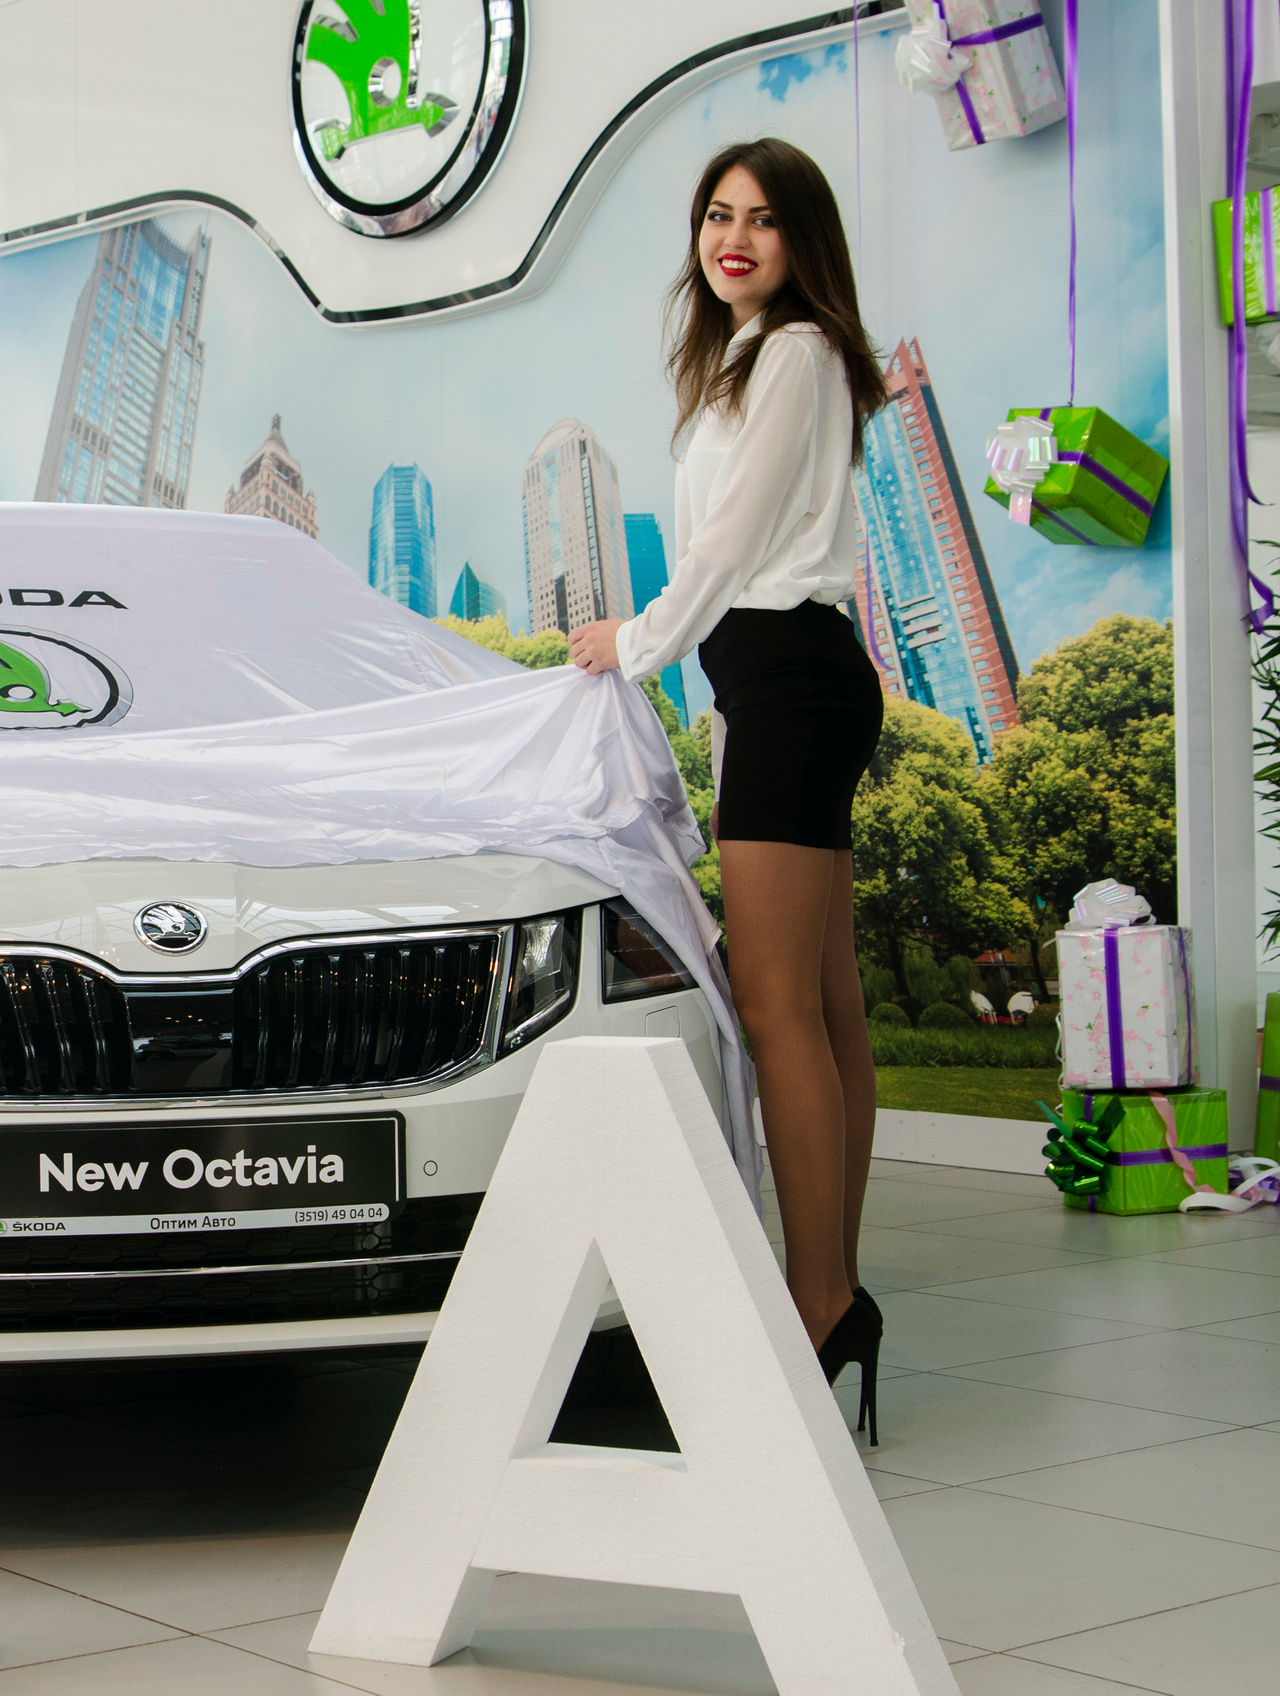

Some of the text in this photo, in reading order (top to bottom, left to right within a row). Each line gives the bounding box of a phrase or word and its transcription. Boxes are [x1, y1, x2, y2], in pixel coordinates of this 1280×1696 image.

[38, 1144, 345, 1193] New Octavia
[149, 1214, 237, 1231] Оптим Авто
[294, 1207, 383, 1223] (3519) 49 04 04
[12, 1220, 67, 1232] ŠKODA
